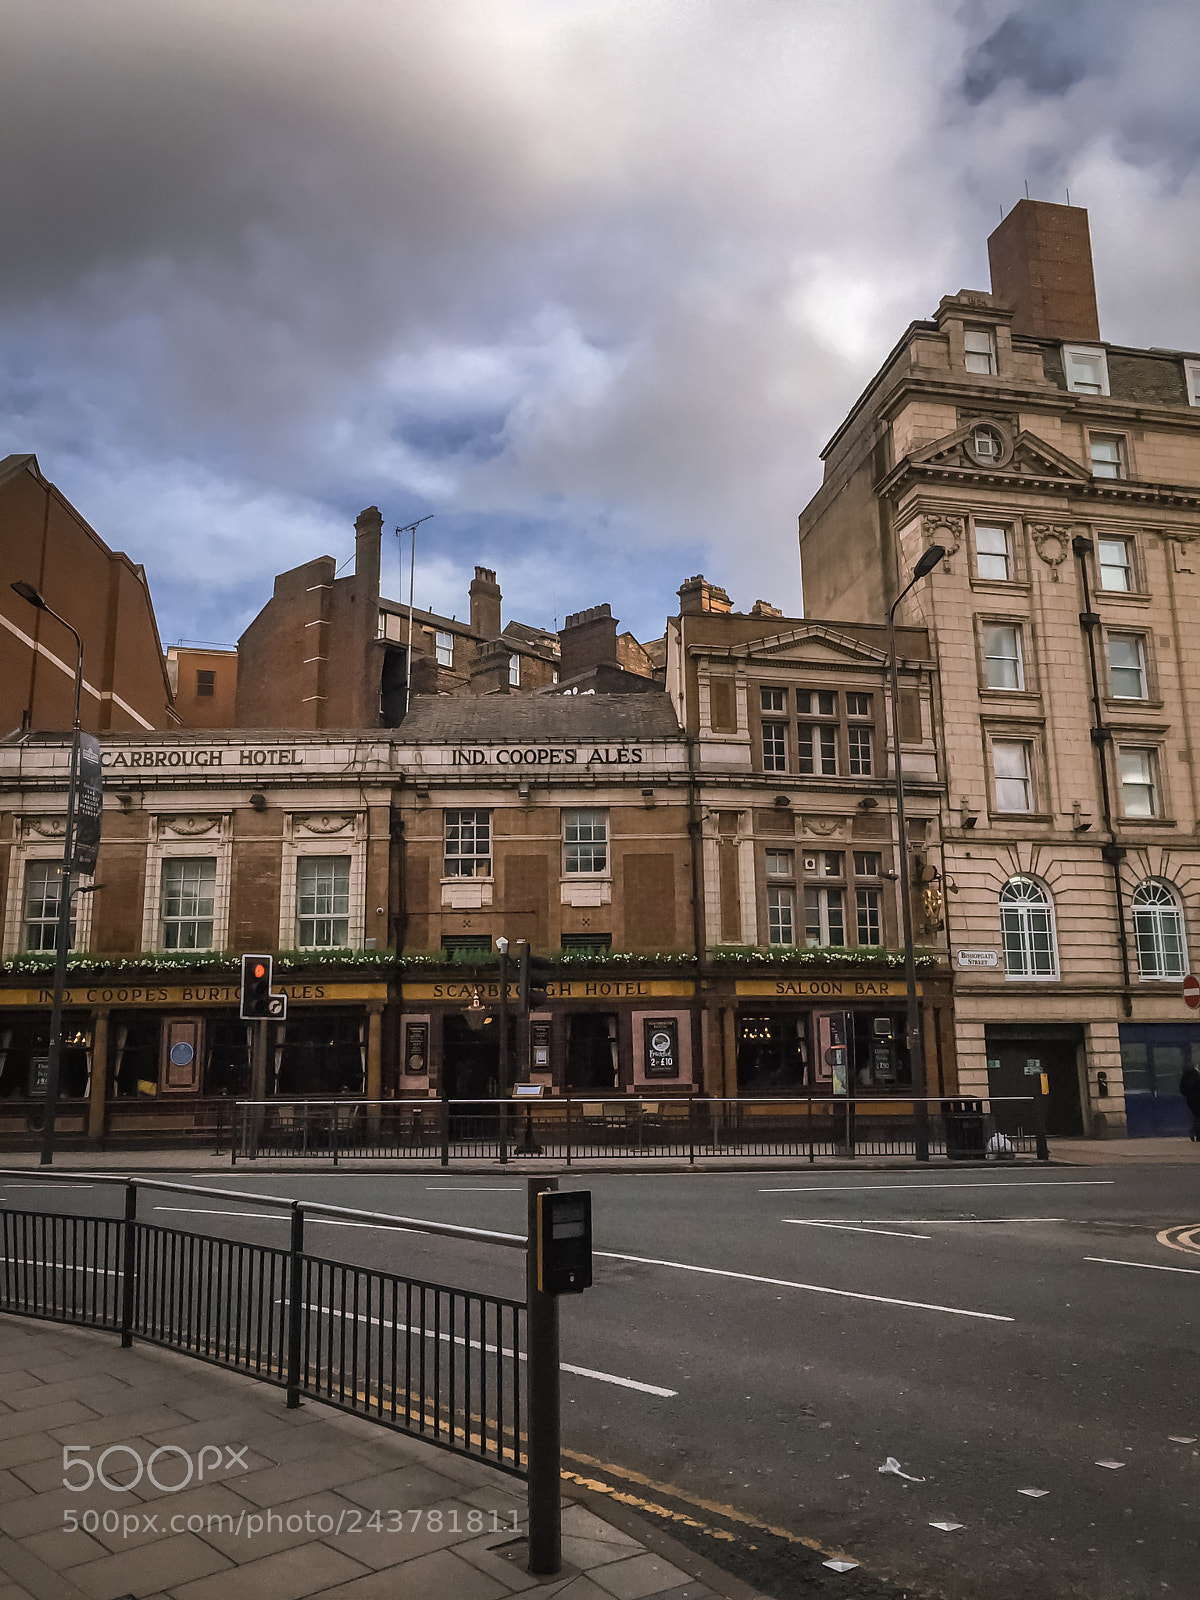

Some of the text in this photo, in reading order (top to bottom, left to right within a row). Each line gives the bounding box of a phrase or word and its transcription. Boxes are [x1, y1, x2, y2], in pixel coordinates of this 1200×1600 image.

[100, 750, 223, 767] CARBROUGH
[239, 750, 303, 766] HOTEL
[452, 749, 488, 765] IND.
[588, 748, 643, 764] ALES
[278, 985, 325, 999] ALES
[586, 982, 649, 996] HOTEL
[775, 981, 889, 995] SALOON BAR
